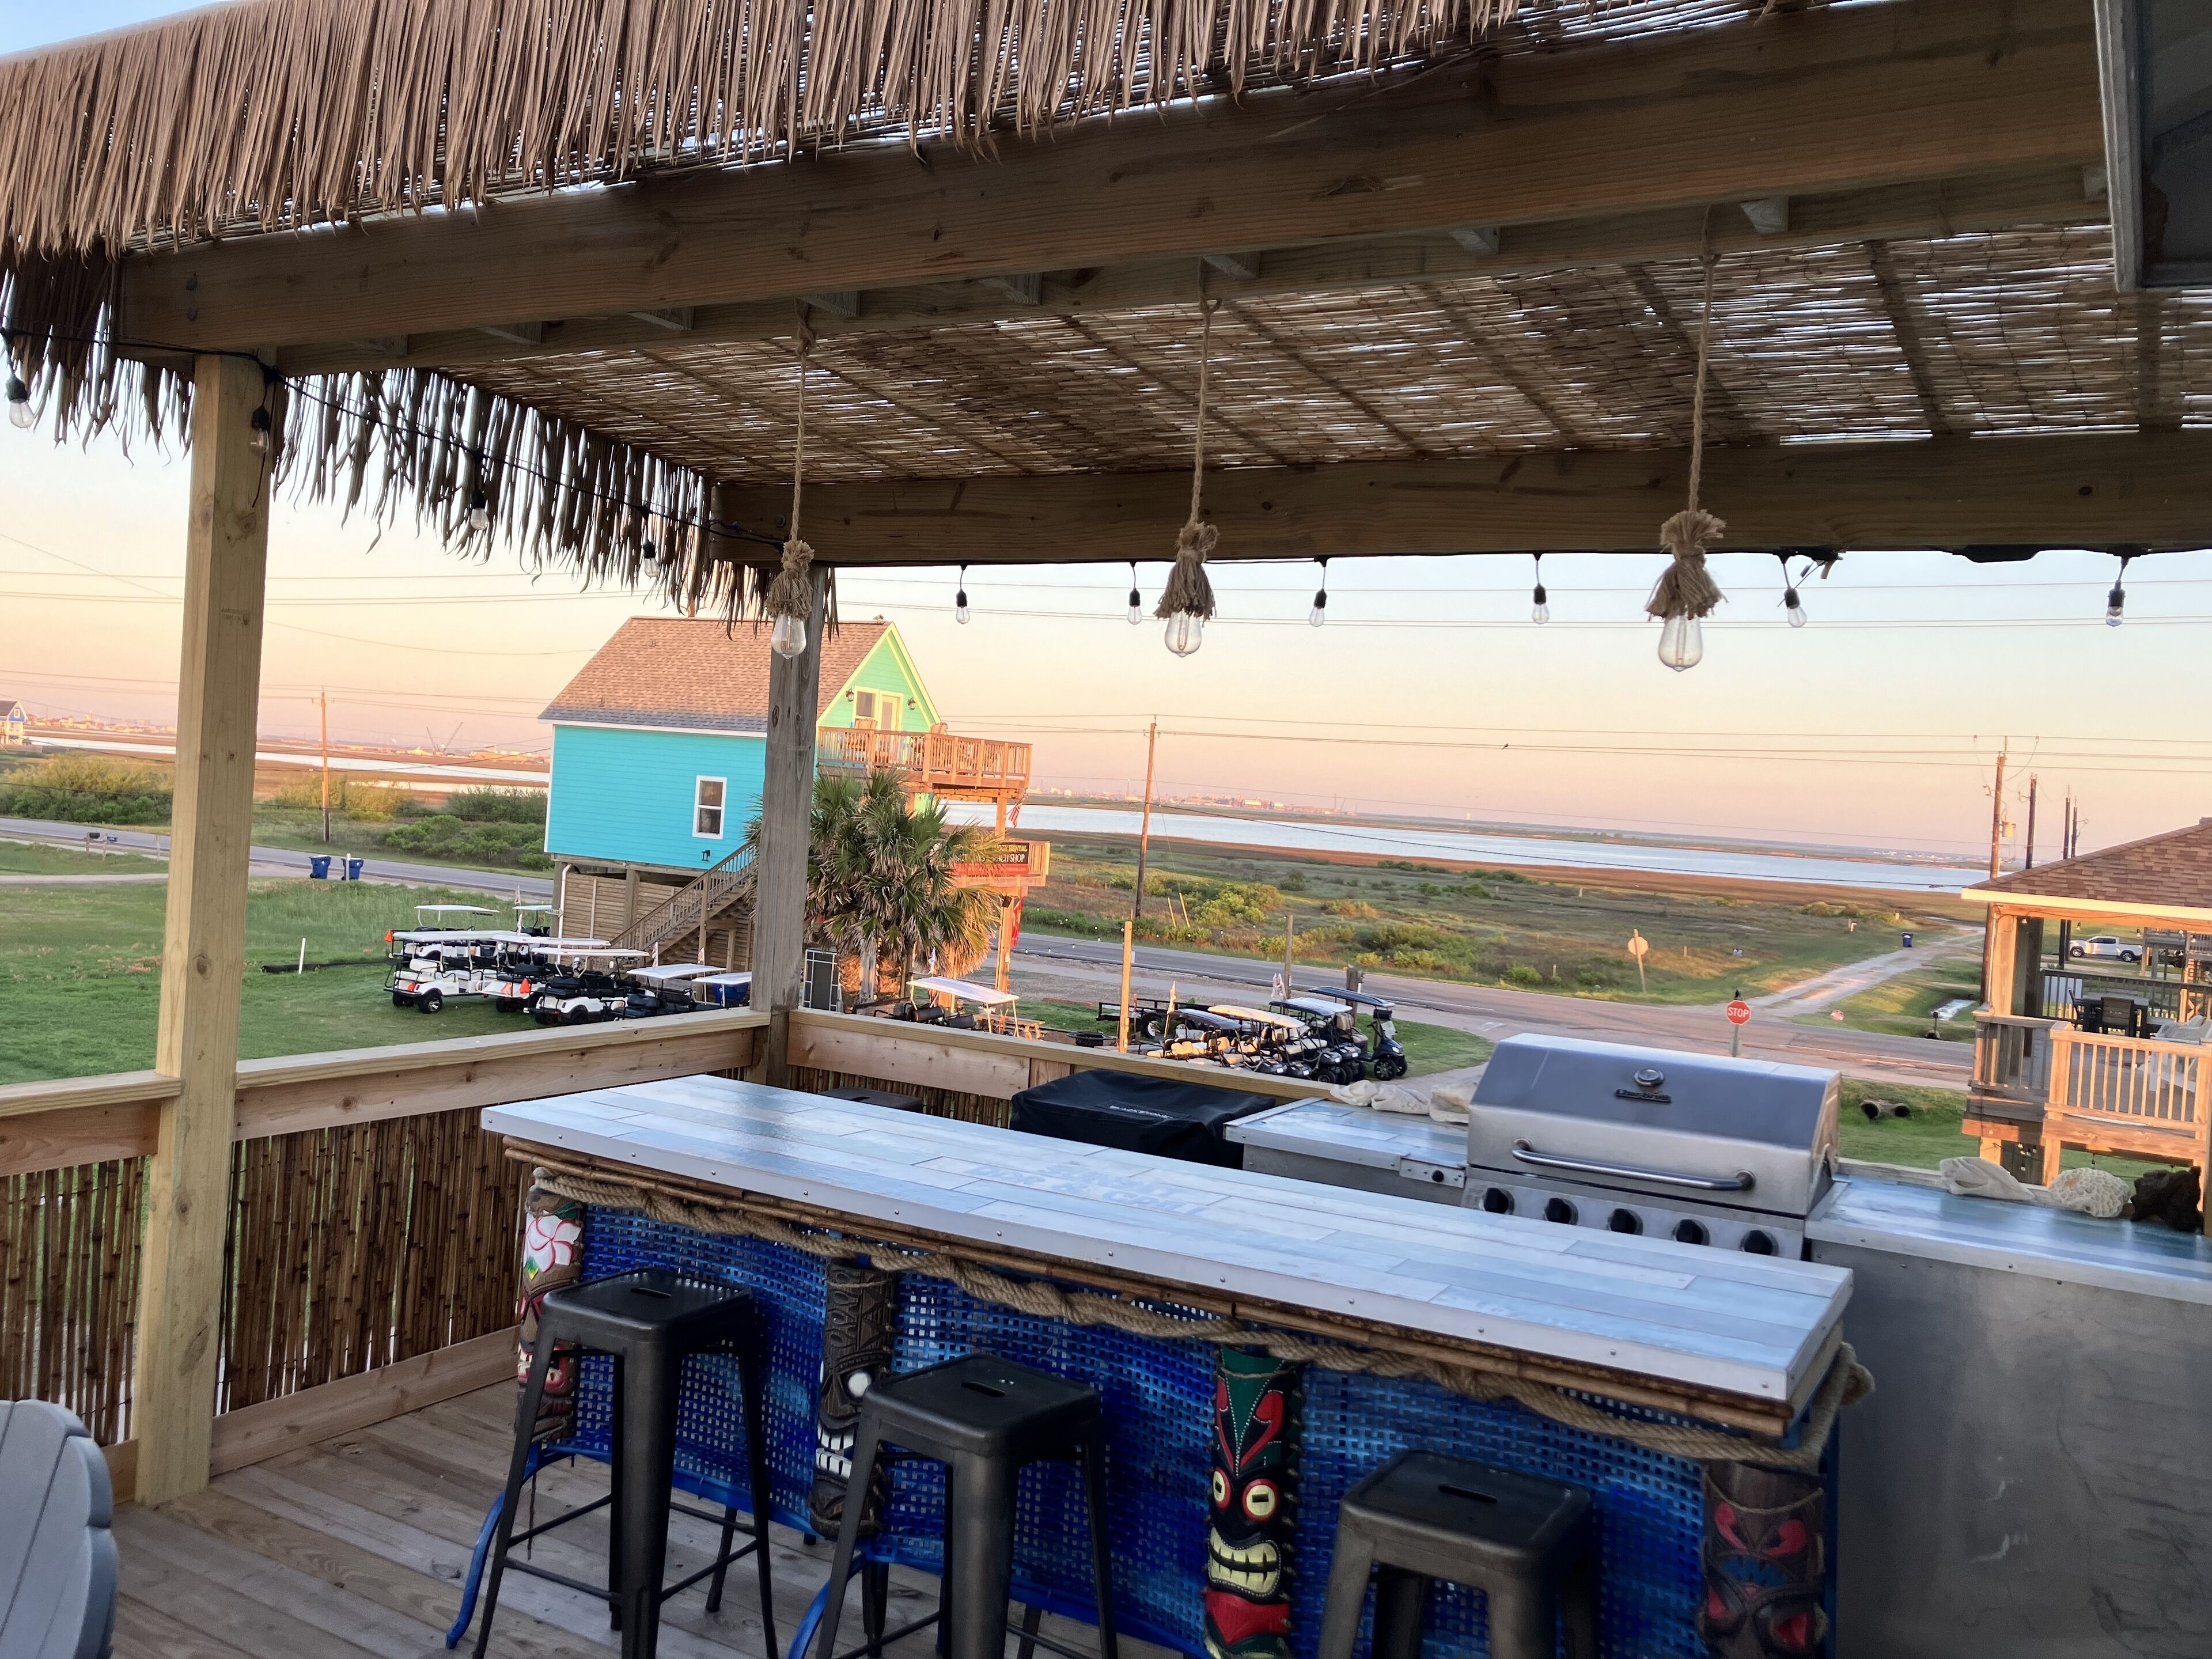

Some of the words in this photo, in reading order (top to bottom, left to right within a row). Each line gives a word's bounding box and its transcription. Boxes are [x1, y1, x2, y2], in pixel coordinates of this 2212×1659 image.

[1010, 854, 1025, 863] SHOP
[1728, 1006, 1749, 1018] STOP
[1051, 1182, 1089, 1194] &
